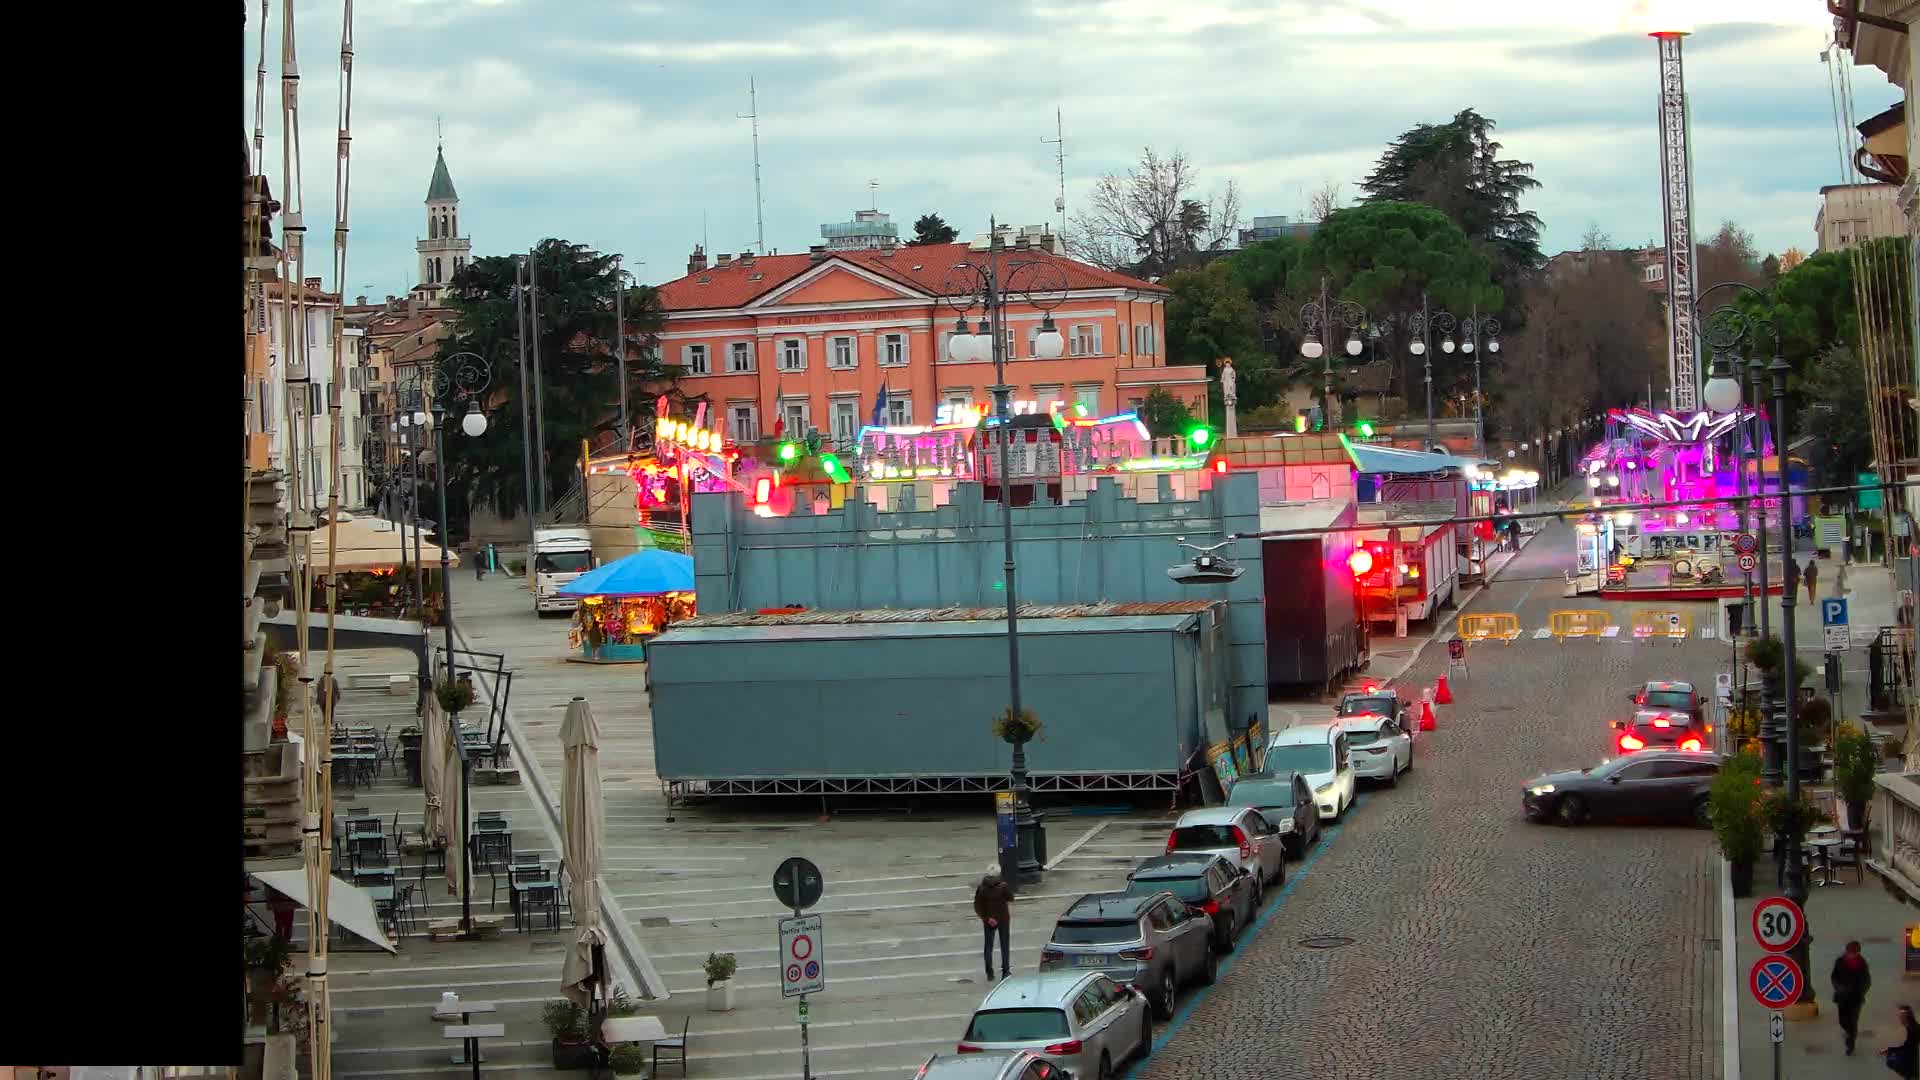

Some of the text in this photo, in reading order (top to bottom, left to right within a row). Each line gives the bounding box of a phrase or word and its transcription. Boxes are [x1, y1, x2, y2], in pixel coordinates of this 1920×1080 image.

[1743, 558, 1752, 566] 20
[1827, 602, 1841, 622] P
[1762, 912, 1791, 937] 30
